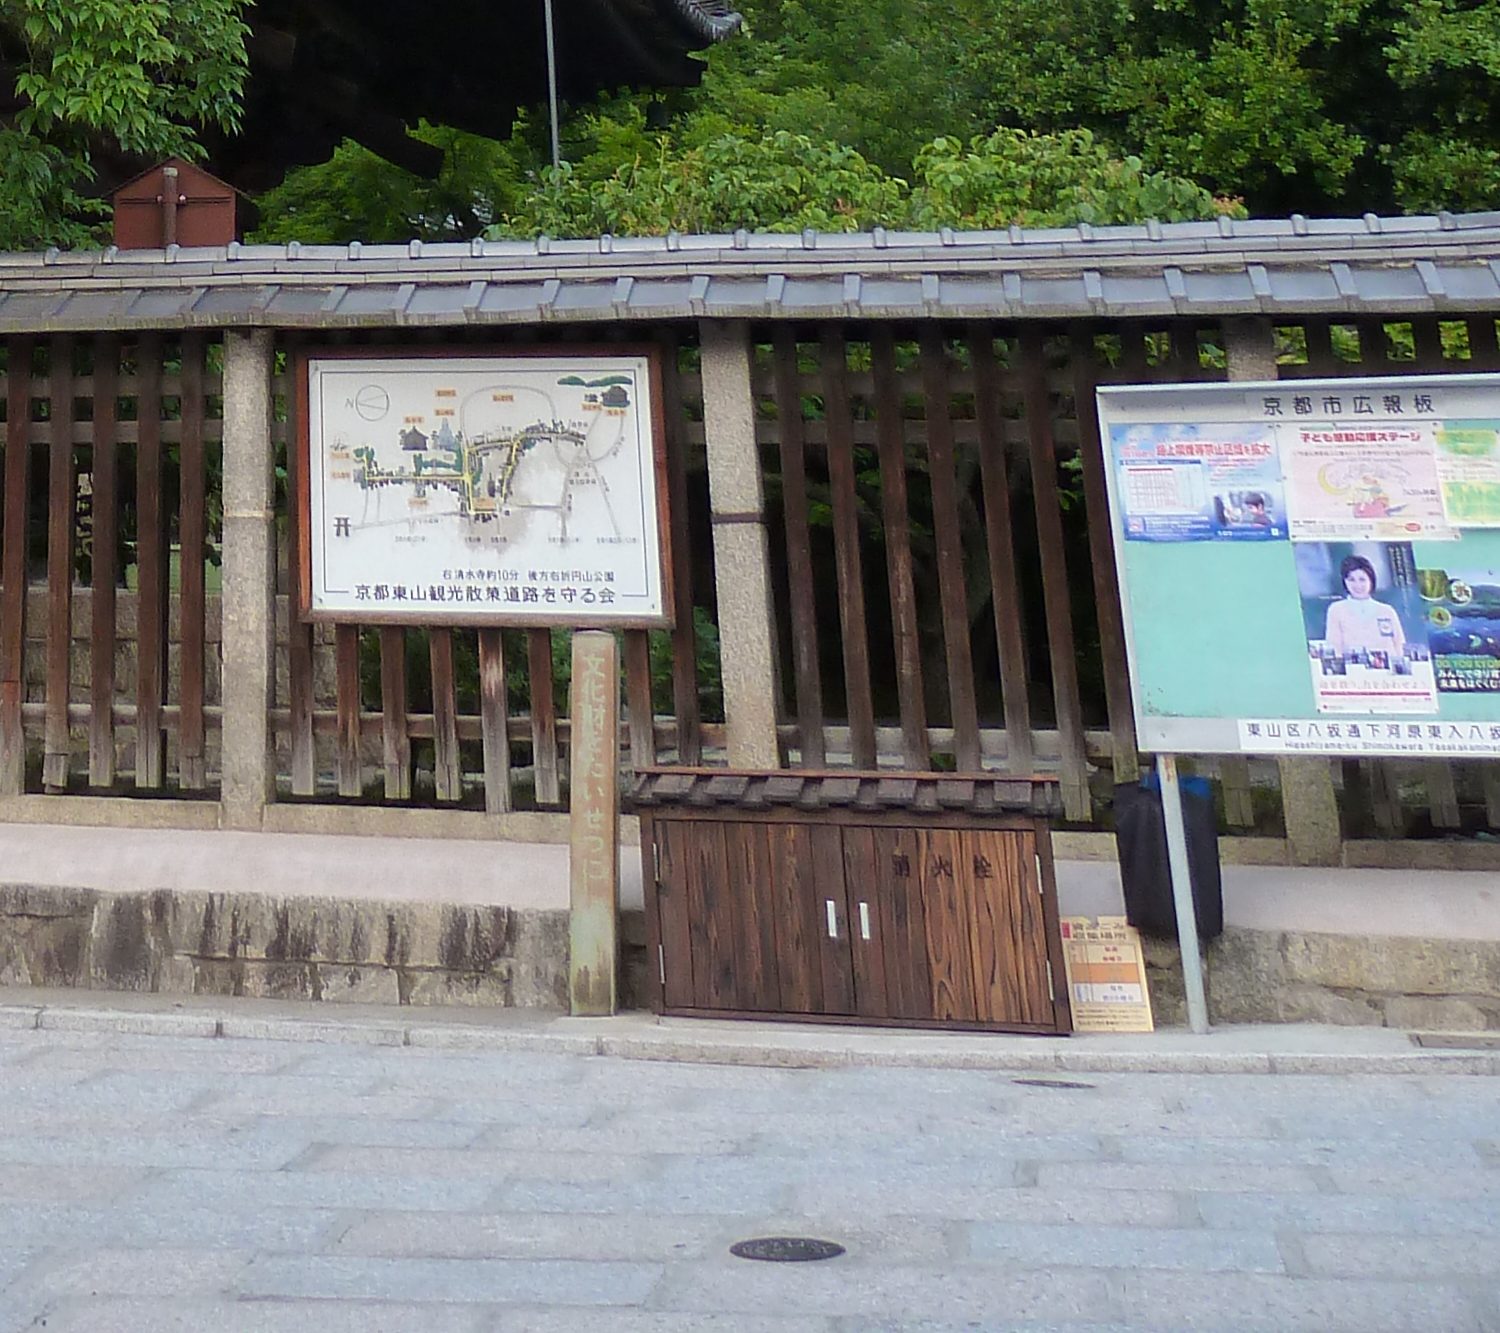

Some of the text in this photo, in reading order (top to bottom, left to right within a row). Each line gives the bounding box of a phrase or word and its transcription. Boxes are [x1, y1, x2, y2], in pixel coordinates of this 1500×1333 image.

[1263, 395, 1435, 416] 京都市広報板
[354, 583, 616, 605] 京都東山観光散策道路を守る会
